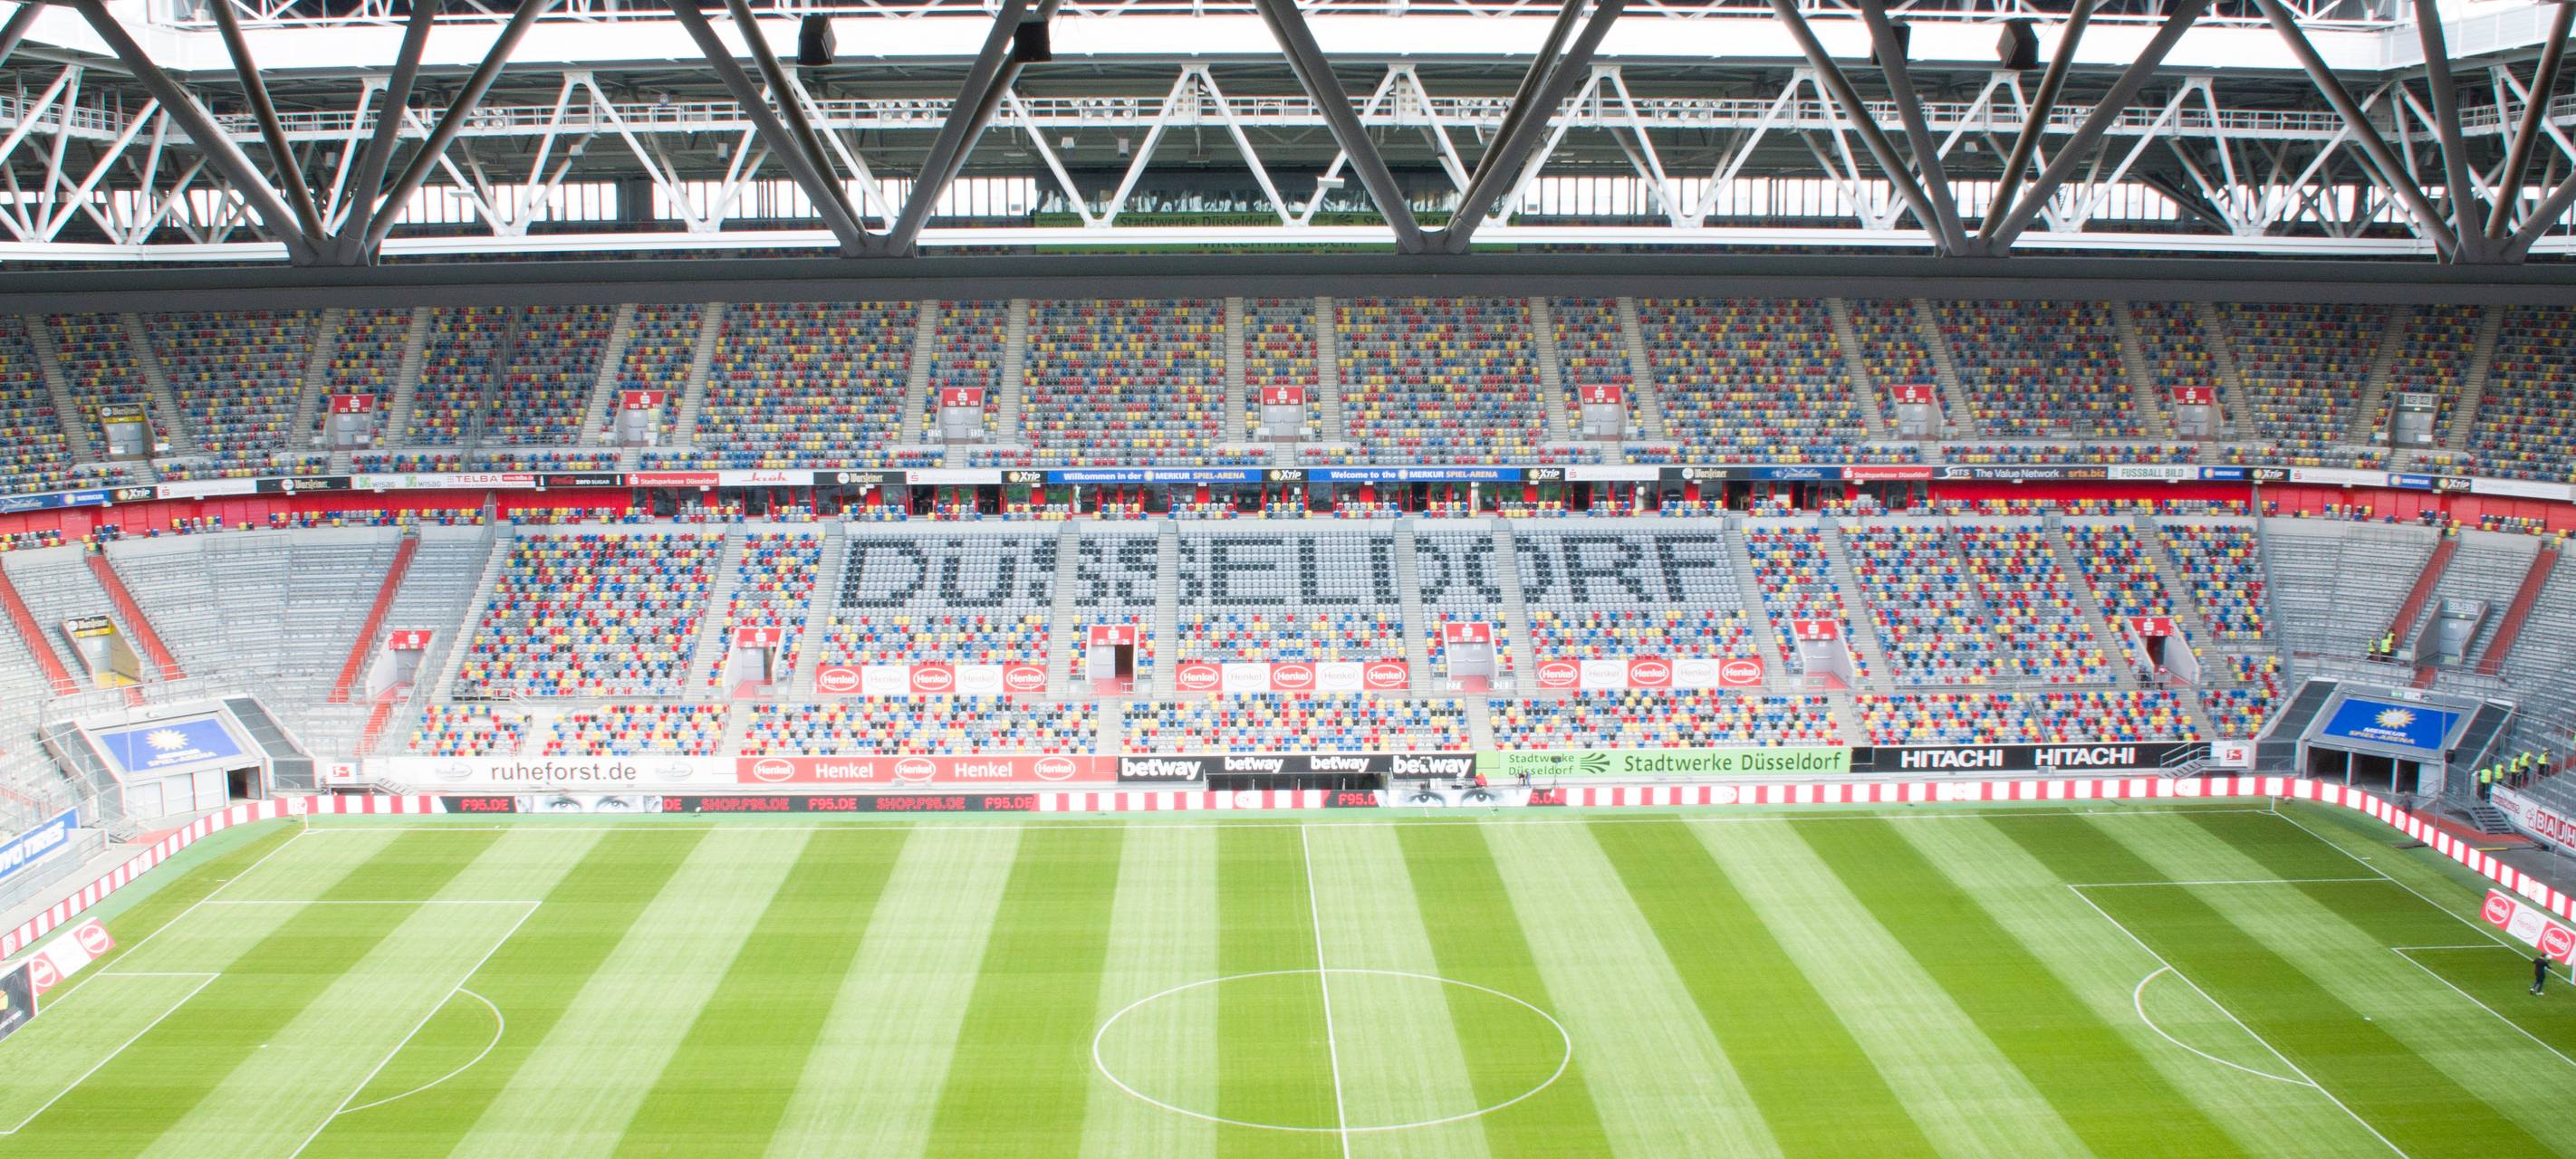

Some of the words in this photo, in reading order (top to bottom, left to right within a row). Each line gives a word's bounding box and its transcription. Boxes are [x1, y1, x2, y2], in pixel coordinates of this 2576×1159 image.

[1120, 214, 1195, 226] Stadtwerke
[1202, 213, 1274, 226] Düsseldorf
[456, 474, 498, 483] TELBA
[1063, 473, 1115, 481] Willkommen
[1155, 472, 1190, 480] MERKUR
[1193, 472, 1245, 480] SPIEL-ARENA
[1331, 471, 1369, 479] Welcome
[1370, 471, 1379, 479] to
[1382, 471, 1396, 479] the
[1409, 471, 1444, 479] MERKUR
[1446, 471, 1498, 479] SPIEL-ARENA
[1854, 472, 1897, 480] Stadtsparkasse
[1975, 468, 1993, 478] The
[1994, 469, 2020, 478] Value
[2068, 469, 2106, 478] srts.biz
[2121, 468, 2163, 478] FUSSBALL
[2165, 468, 2184, 478] BILD
[841, 534, 1716, 608] DÜSSELDORF
[1182, 671, 1216, 683] Henkel
[1276, 671, 1309, 682] Henkel
[1370, 670, 1403, 682] Henkel
[1541, 668, 1576, 679] Henkel
[1633, 668, 1668, 679] Henkel
[1724, 666, 1757, 678] Henkel
[822, 674, 858, 685] Henkel
[913, 673, 950, 685] Henkel
[1009, 673, 1043, 684] Henkel
[1509, 753, 1574, 763] Stadtwke
[1624, 754, 1732, 772] Stadtwerke
[1741, 752, 1841, 771] Düsseldorf
[1901, 750, 2004, 768] HITACHI
[2035, 747, 2135, 765] HITACHI
[756, 764, 792, 775] Henkel
[898, 763, 933, 774] Henkel
[954, 761, 1014, 778] Henkel
[1038, 763, 1072, 774] Henkel
[1121, 758, 1201, 781] betway
[1225, 756, 1283, 773] betway
[1311, 755, 1370, 772] betway
[492, 761, 637, 781] ruheforst.de
[816, 761, 874, 779] Henkel
[461, 799, 509, 811] F95.DE
[701, 798, 790, 810] SHOP.F95.DE
[809, 798, 857, 810] F95.DE
[877, 797, 966, 810] SHOP.F95.DE
[2487, 900, 2508, 919] Henkel
[2544, 932, 2570, 953] Henkel
